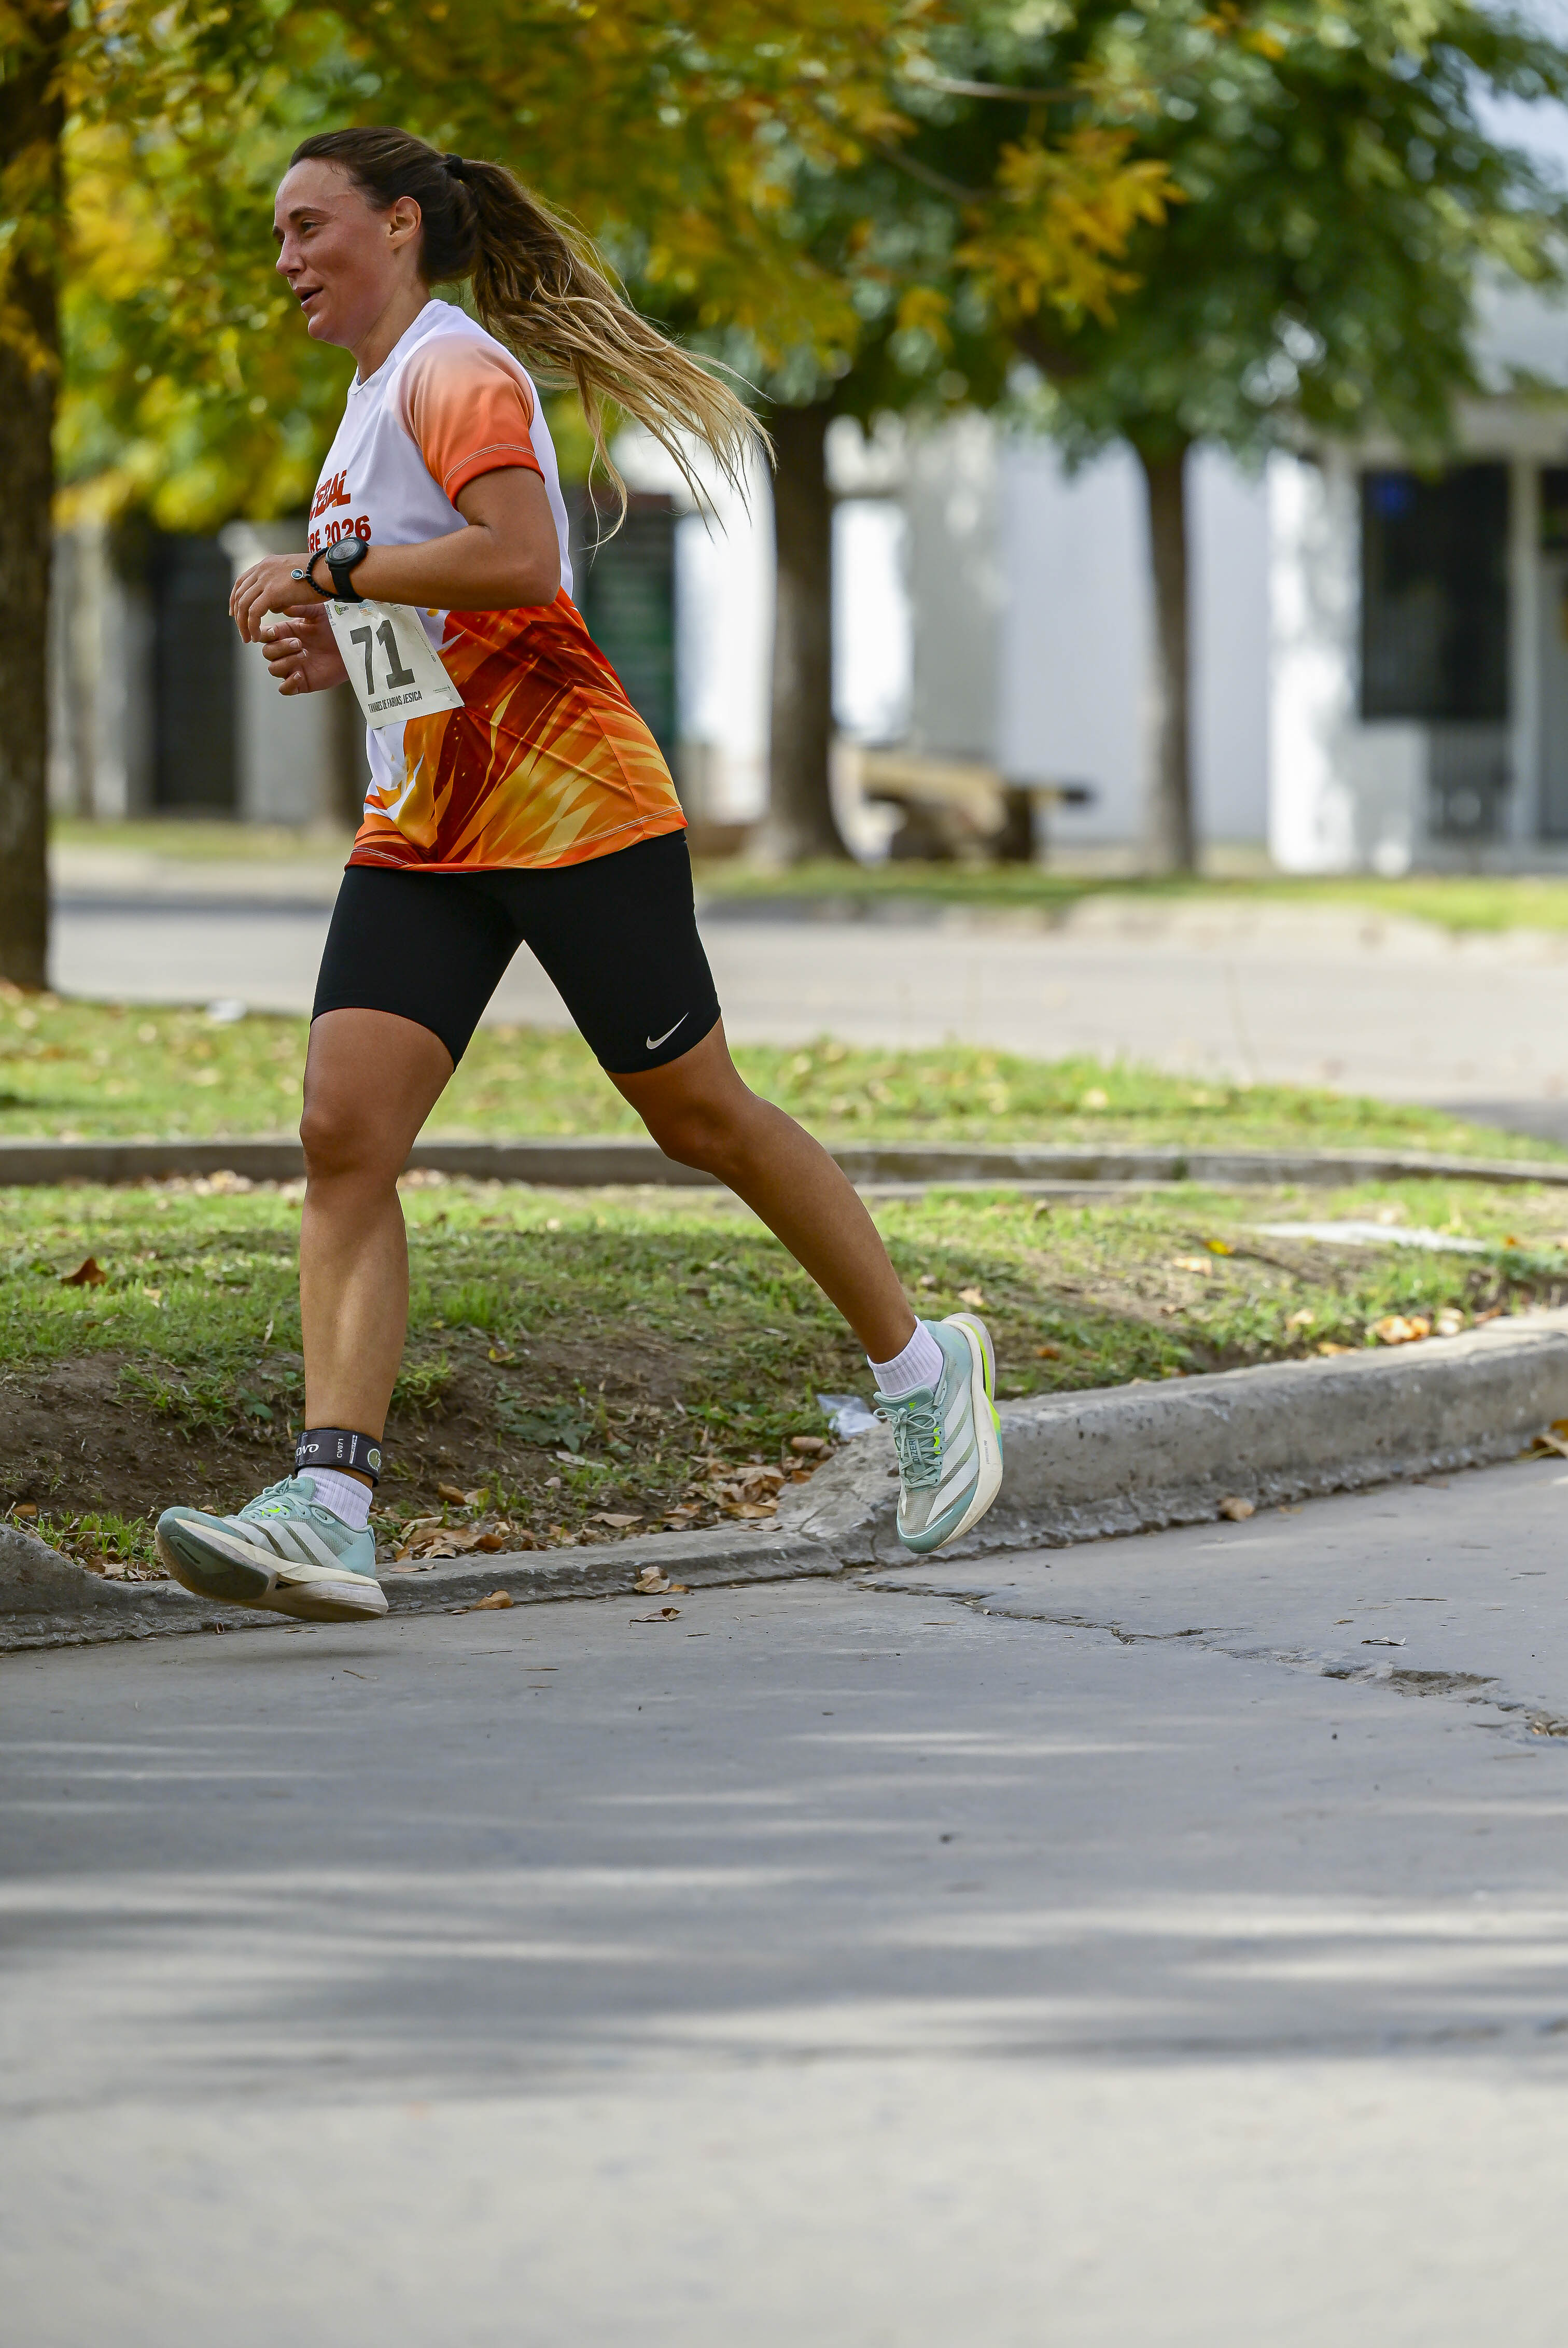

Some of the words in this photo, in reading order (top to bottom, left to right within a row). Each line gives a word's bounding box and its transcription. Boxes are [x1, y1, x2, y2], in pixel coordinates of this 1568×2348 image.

[307, 528, 321, 553] RE
[325, 515, 372, 548] 2026
[349, 619, 416, 695] 71
[387, 695, 403, 708] FARIAS
[403, 690, 423, 704] JESICA
